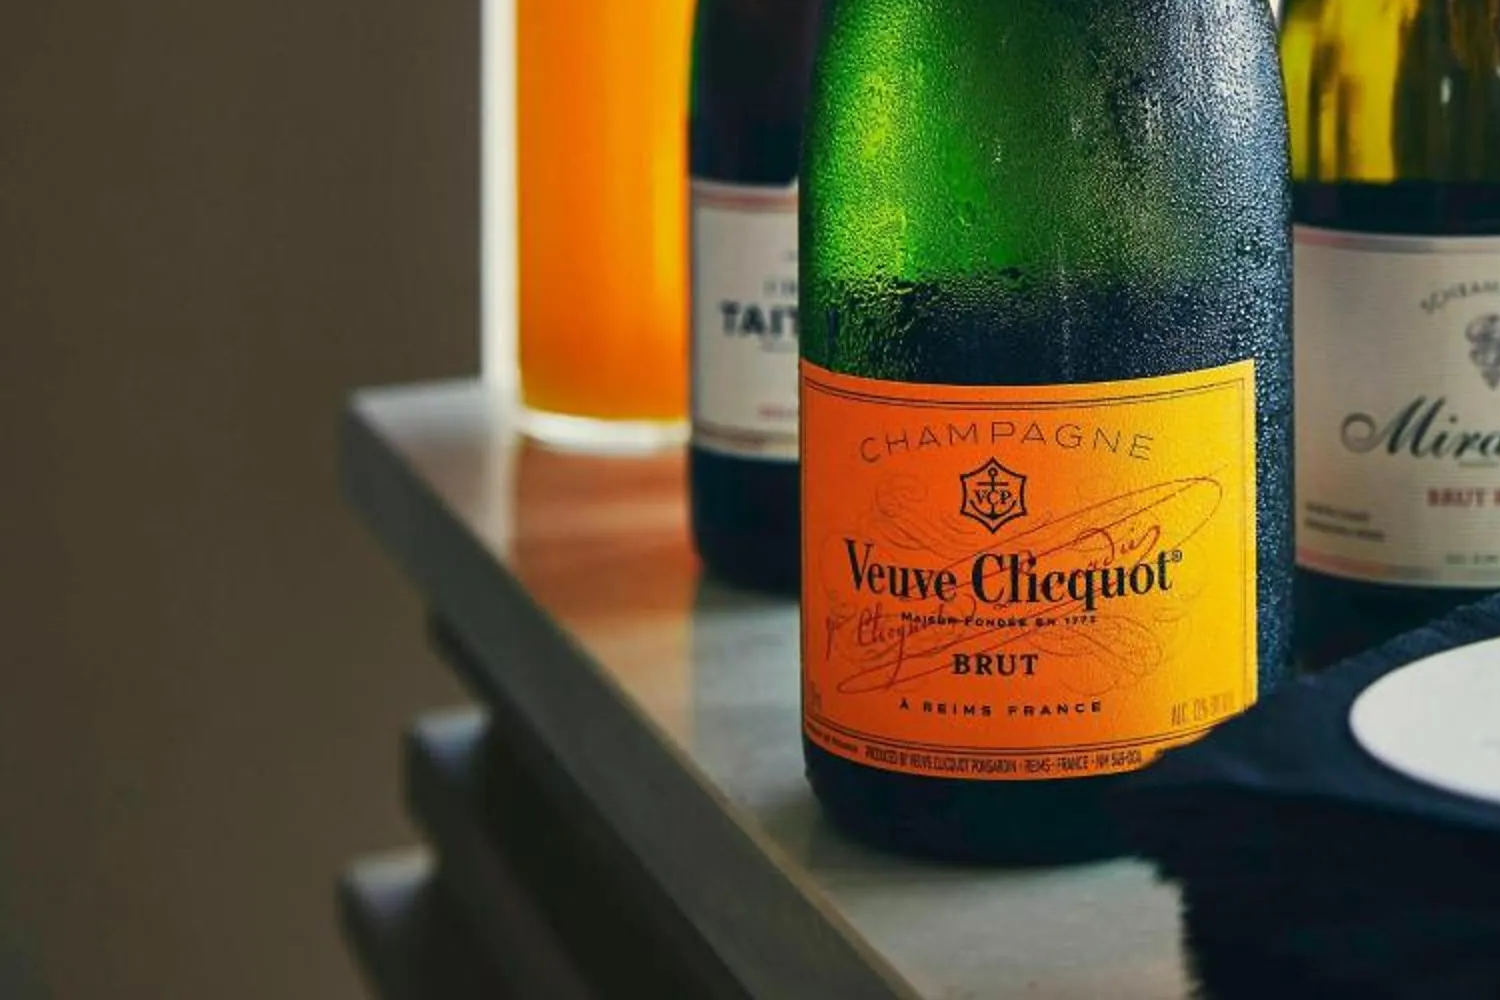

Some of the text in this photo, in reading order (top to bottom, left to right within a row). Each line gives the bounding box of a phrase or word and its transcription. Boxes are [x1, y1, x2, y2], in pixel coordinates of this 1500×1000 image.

[860, 421, 1154, 463] CHAMPAGNE
[1427, 487, 1485, 508] BRUT
[843, 538, 957, 601] Veuve
[952, 653, 1039, 677] BRUT
[922, 701, 992, 717] REIMS
[1007, 700, 1101, 717] FRANCE
